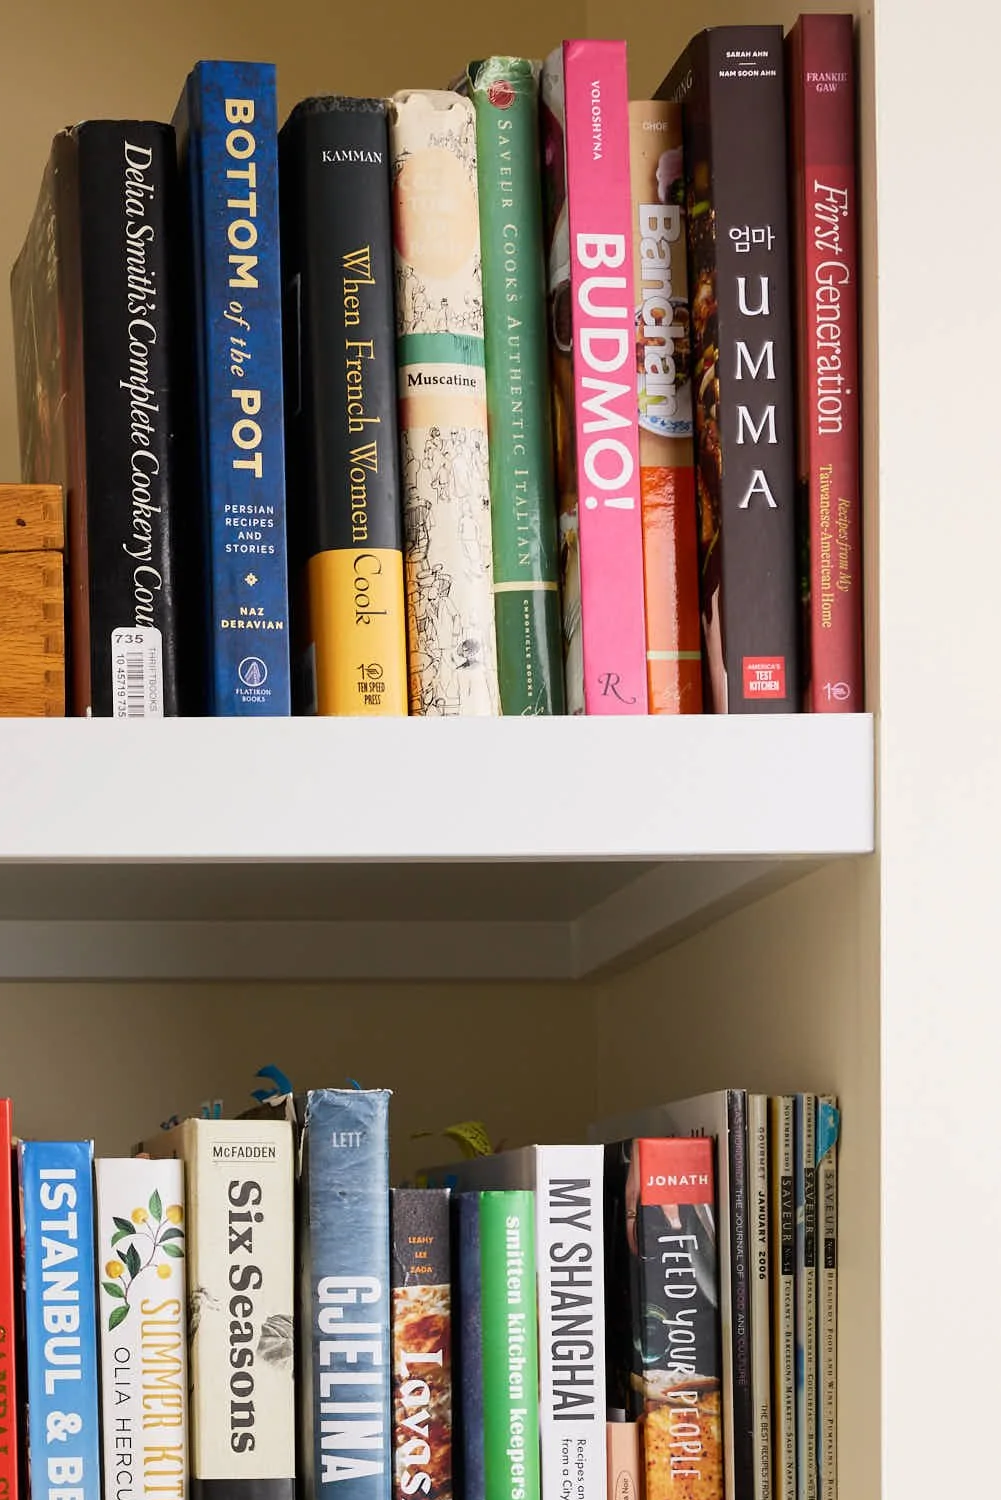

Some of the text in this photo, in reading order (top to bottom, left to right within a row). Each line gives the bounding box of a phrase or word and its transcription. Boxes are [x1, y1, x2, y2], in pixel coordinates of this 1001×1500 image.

[591, 80, 603, 161] VOLOSHYNA
[322, 150, 383, 164] KAMMAN
[729, 226, 775, 252] 엄마
[224, 97, 263, 479] BOTTOM of the POT
[638, 203, 686, 417] Banchan
[814, 180, 852, 435] First Generation
[119, 140, 162, 561] Delia Smith's Complete Cookery
[498, 119, 530, 566] SAVEUR AUTHENTIC ITALIAN
[576, 232, 635, 510] BUDMO!
[407, 372, 477, 388] Muscatine
[735, 276, 778, 509] UMMA
[342, 246, 387, 626] When French Women Cook
[224, 504, 275, 515] PERSIAN
[225, 517, 274, 528] RECIPES
[237, 531, 262, 541] AND
[225, 543, 275, 554] STORIES
[115, 634, 144, 644] 735
[221, 619, 284, 630] DERAVIAN
[239, 607, 265, 616] NAZ
[212, 1146, 276, 1158] McFADDEN
[332, 1132, 362, 1148] LETT
[646, 1175, 708, 1187] JONATH
[39, 1168, 82, 1395] ISTANBUL
[227, 1180, 264, 1453] Six Seasons
[549, 1178, 595, 1421] MY SHANGHAI
[114, 1346, 132, 1406] OLIA
[140, 1298, 185, 1430] SUMMER
[317, 1276, 384, 1483] GJELINA
[505, 1215, 528, 1500] smitten kitchen keepers
[657, 1234, 702, 1487] FEED YOUR PEOPLE
[46, 1411, 83, 1444] &
[575, 1439, 588, 1481] Recipes
